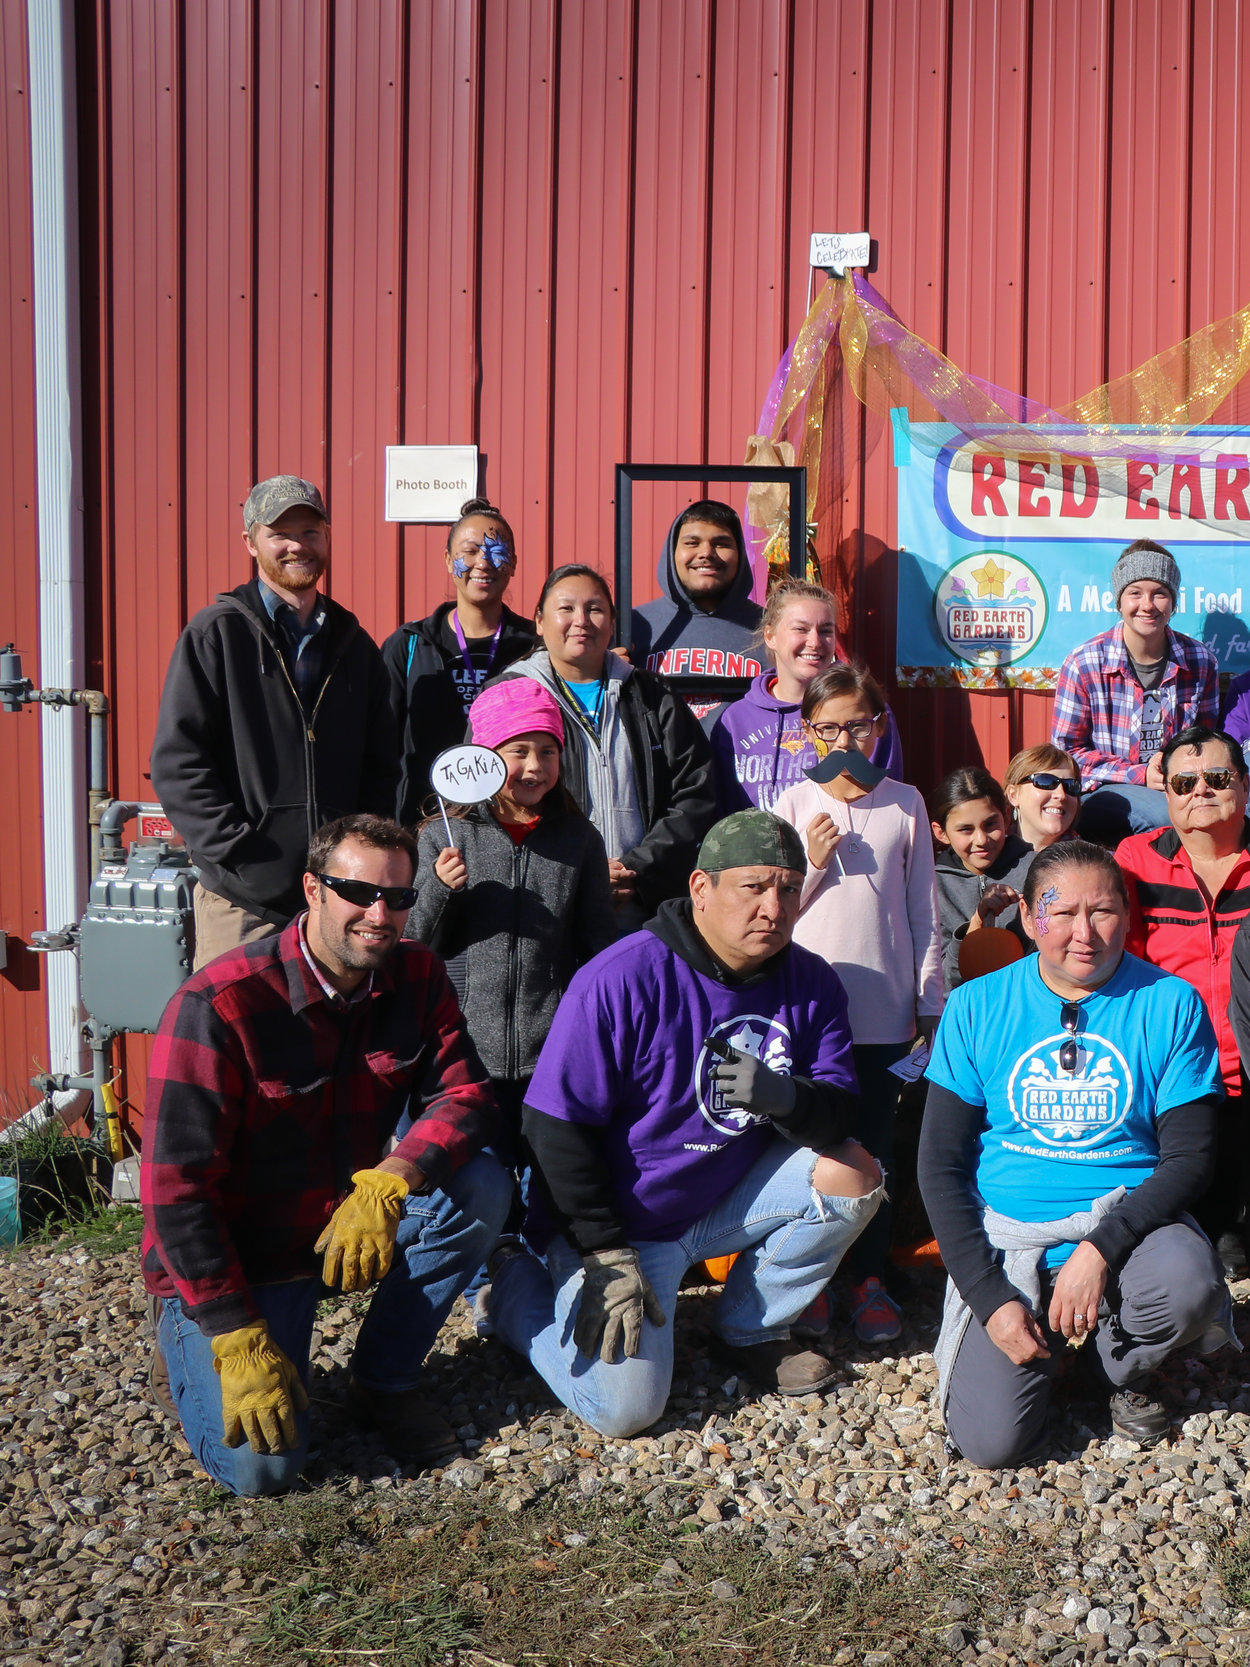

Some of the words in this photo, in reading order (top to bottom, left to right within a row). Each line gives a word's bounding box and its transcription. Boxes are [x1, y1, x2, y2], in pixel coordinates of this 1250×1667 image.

[814, 236, 841, 249] LETS
[396, 480, 430, 490] Photo
[433, 479, 467, 490] Booth
[972, 453, 1099, 518] RED
[1057, 585, 1072, 612] A
[1195, 587, 1242, 614] Food
[953, 610, 979, 622] RED
[984, 611, 1025, 622] EARTH
[953, 625, 1026, 639] GARDENS
[646, 648, 761, 677] INFERNO
[740, 719, 799, 750] UNIVERS
[735, 751, 816, 783] NORTHE
[1029, 1091, 1058, 1104] RED
[1062, 1091, 1107, 1104] EARTH
[1029, 1105, 1107, 1121] GARDENS
[1001, 1140, 1132, 1160] www.RedEarthGardens.com
